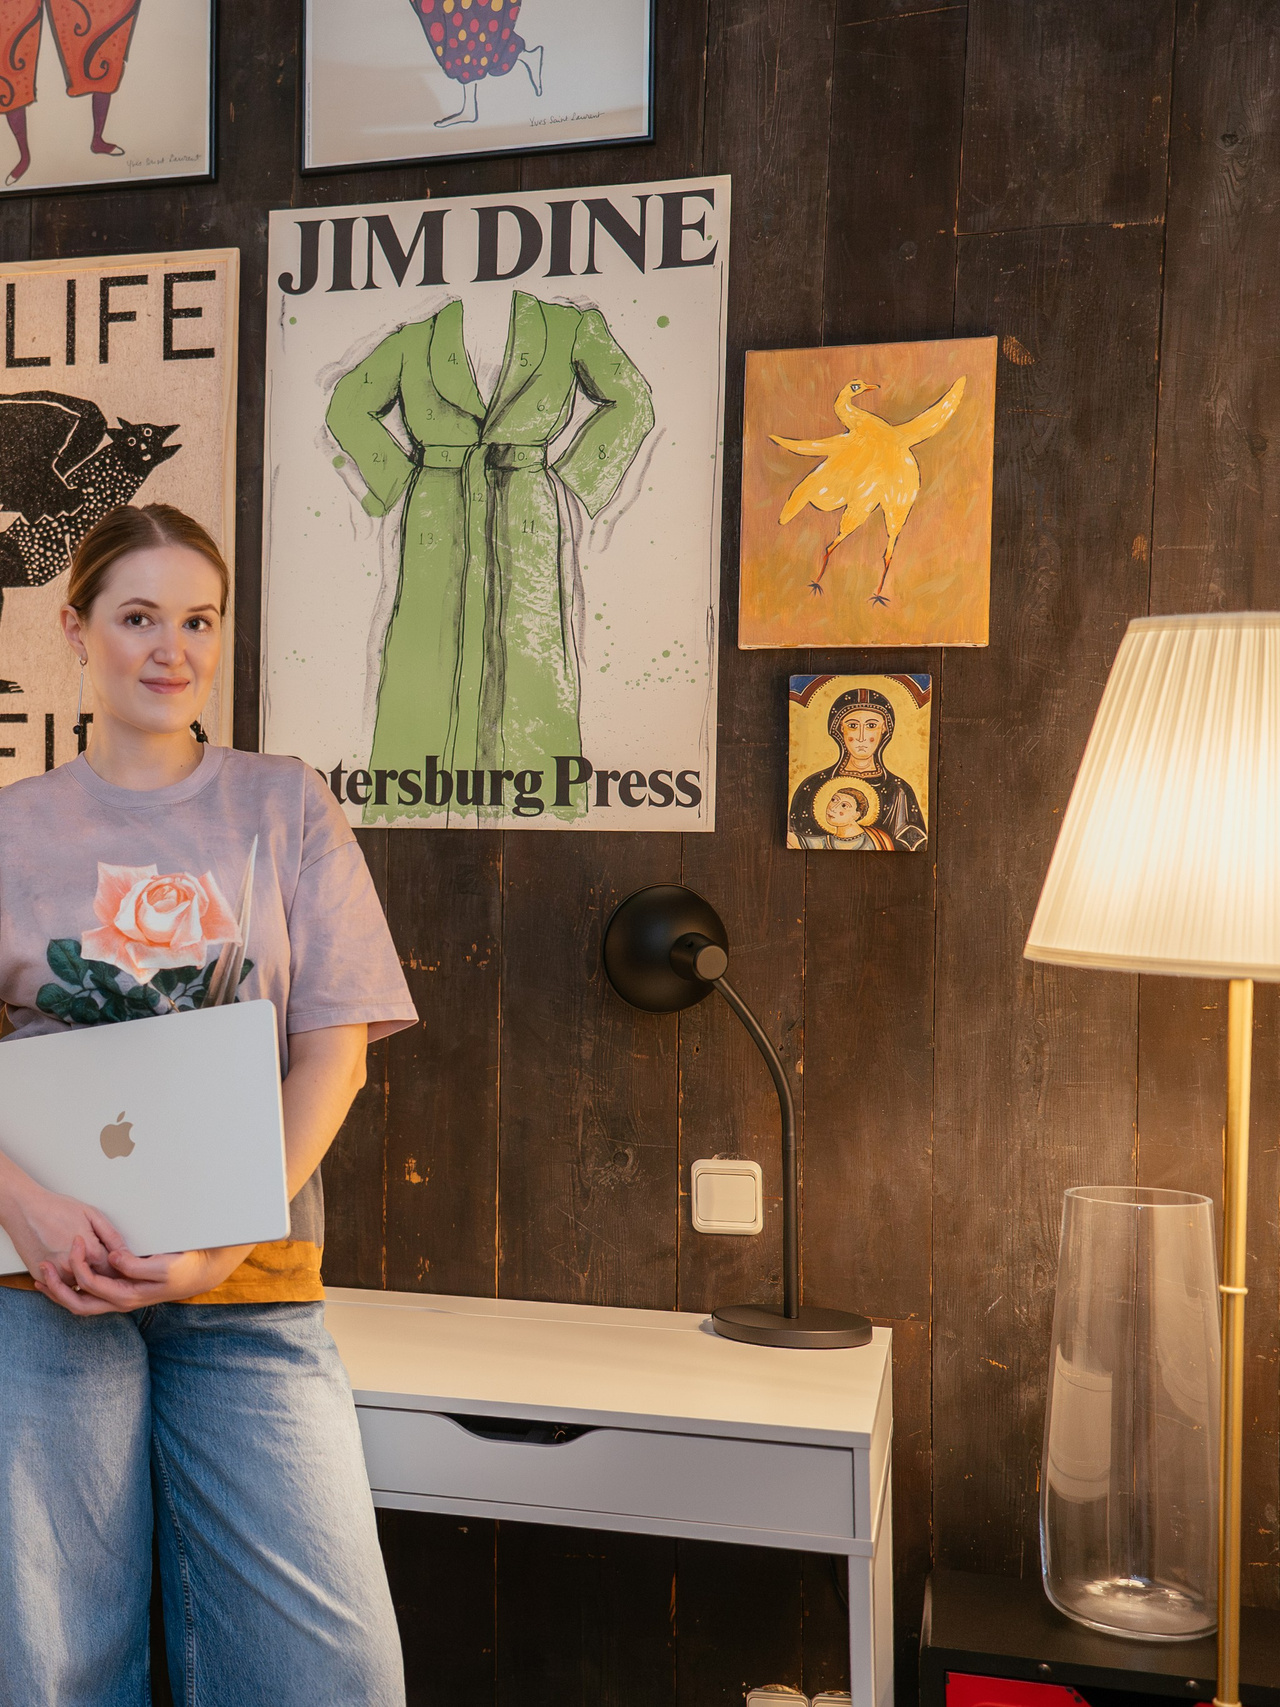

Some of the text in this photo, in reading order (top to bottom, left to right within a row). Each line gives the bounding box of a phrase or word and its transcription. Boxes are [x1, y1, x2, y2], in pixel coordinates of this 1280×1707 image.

[528, 112, 605, 127] Yves Saint Laurent
[277, 188, 719, 296] JIM DINE
[5, 270, 217, 369] LIFE
[287, 755, 703, 818] tersburg Press
